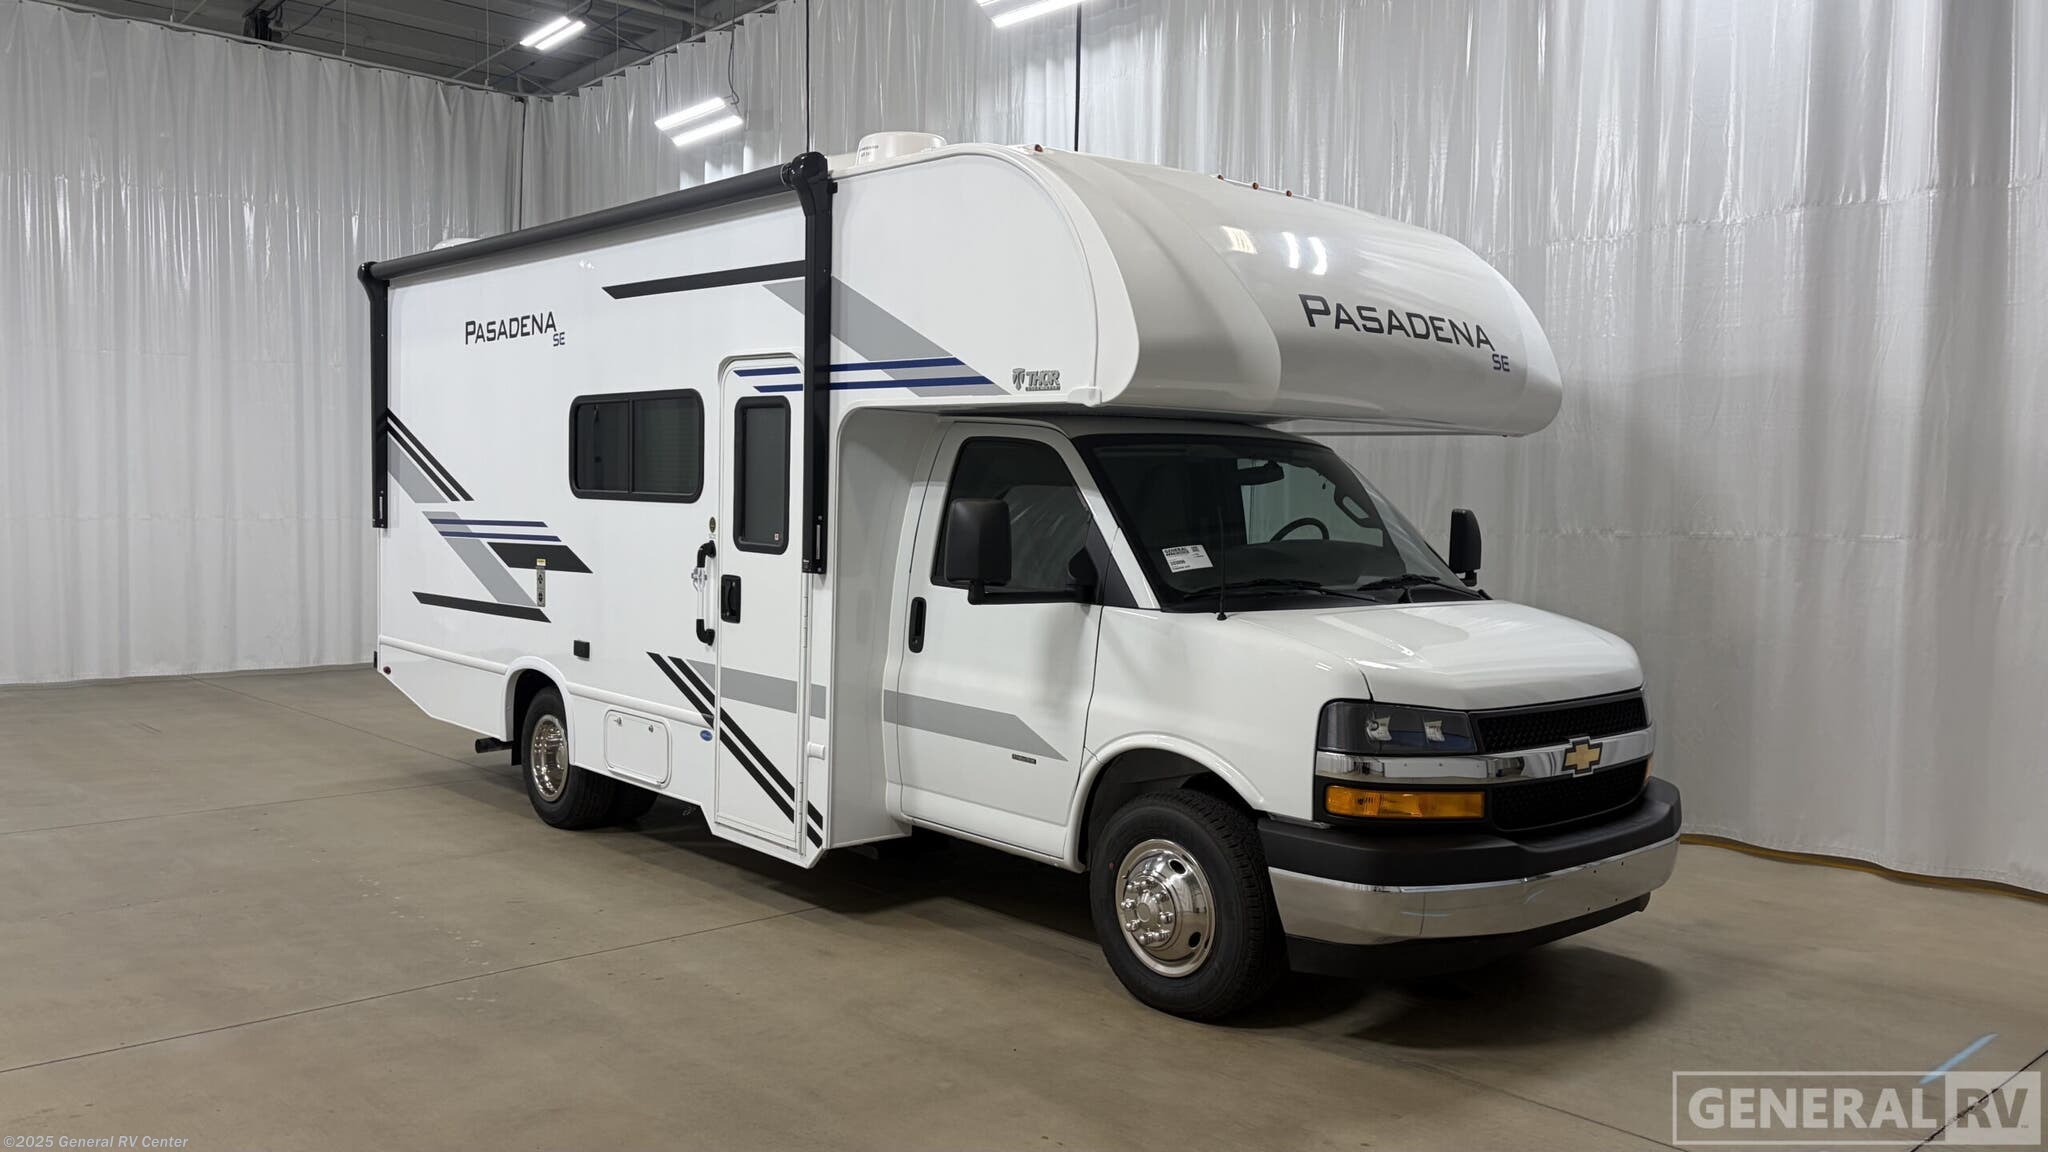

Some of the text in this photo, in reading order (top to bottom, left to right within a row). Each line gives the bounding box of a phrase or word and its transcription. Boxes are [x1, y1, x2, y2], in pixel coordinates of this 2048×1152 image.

[465, 311, 557, 345] PASADENA
[1299, 294, 1496, 352] PASADENA
[553, 332, 565, 347] SE
[1492, 353, 1510, 372] SE
[1026, 370, 1061, 386] THOR
